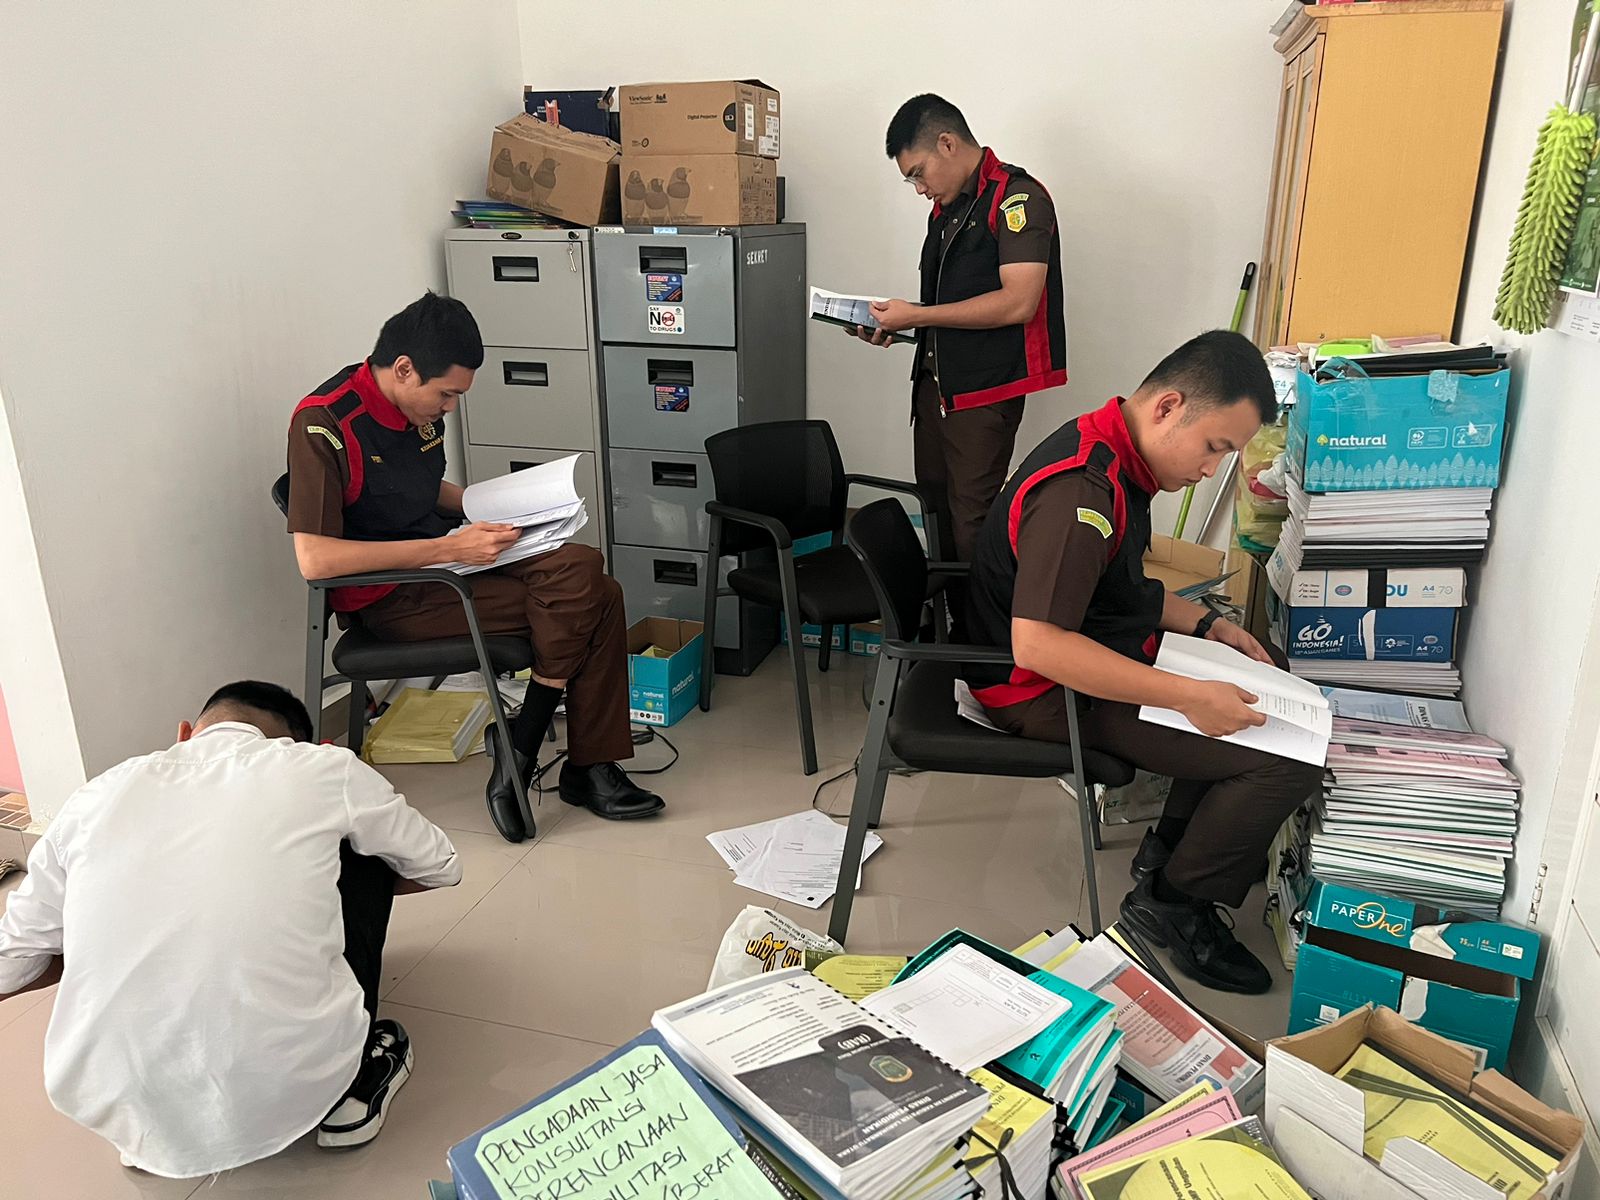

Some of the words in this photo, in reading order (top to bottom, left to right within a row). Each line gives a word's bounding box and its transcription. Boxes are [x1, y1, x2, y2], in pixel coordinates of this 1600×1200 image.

[746, 249, 768, 265] SEKRET
[1329, 434, 1387, 446] natural
[1386, 585, 1408, 597] DU
[1298, 624, 1333, 641] GO
[1292, 635, 1345, 649] INDONESIA!
[1331, 903, 1376, 923] PAPER
[837, 1033, 871, 1050] (RAB)
[908, 1095, 932, 1110] DINAS
[482, 1086, 613, 1176] PENGADAAN
[613, 1053, 666, 1097] JASA
[862, 1105, 909, 1135] PENDIDIKAN
[504, 1097, 647, 1198] KONSULTANSI
[604, 1145, 688, 1200] ILITASI
